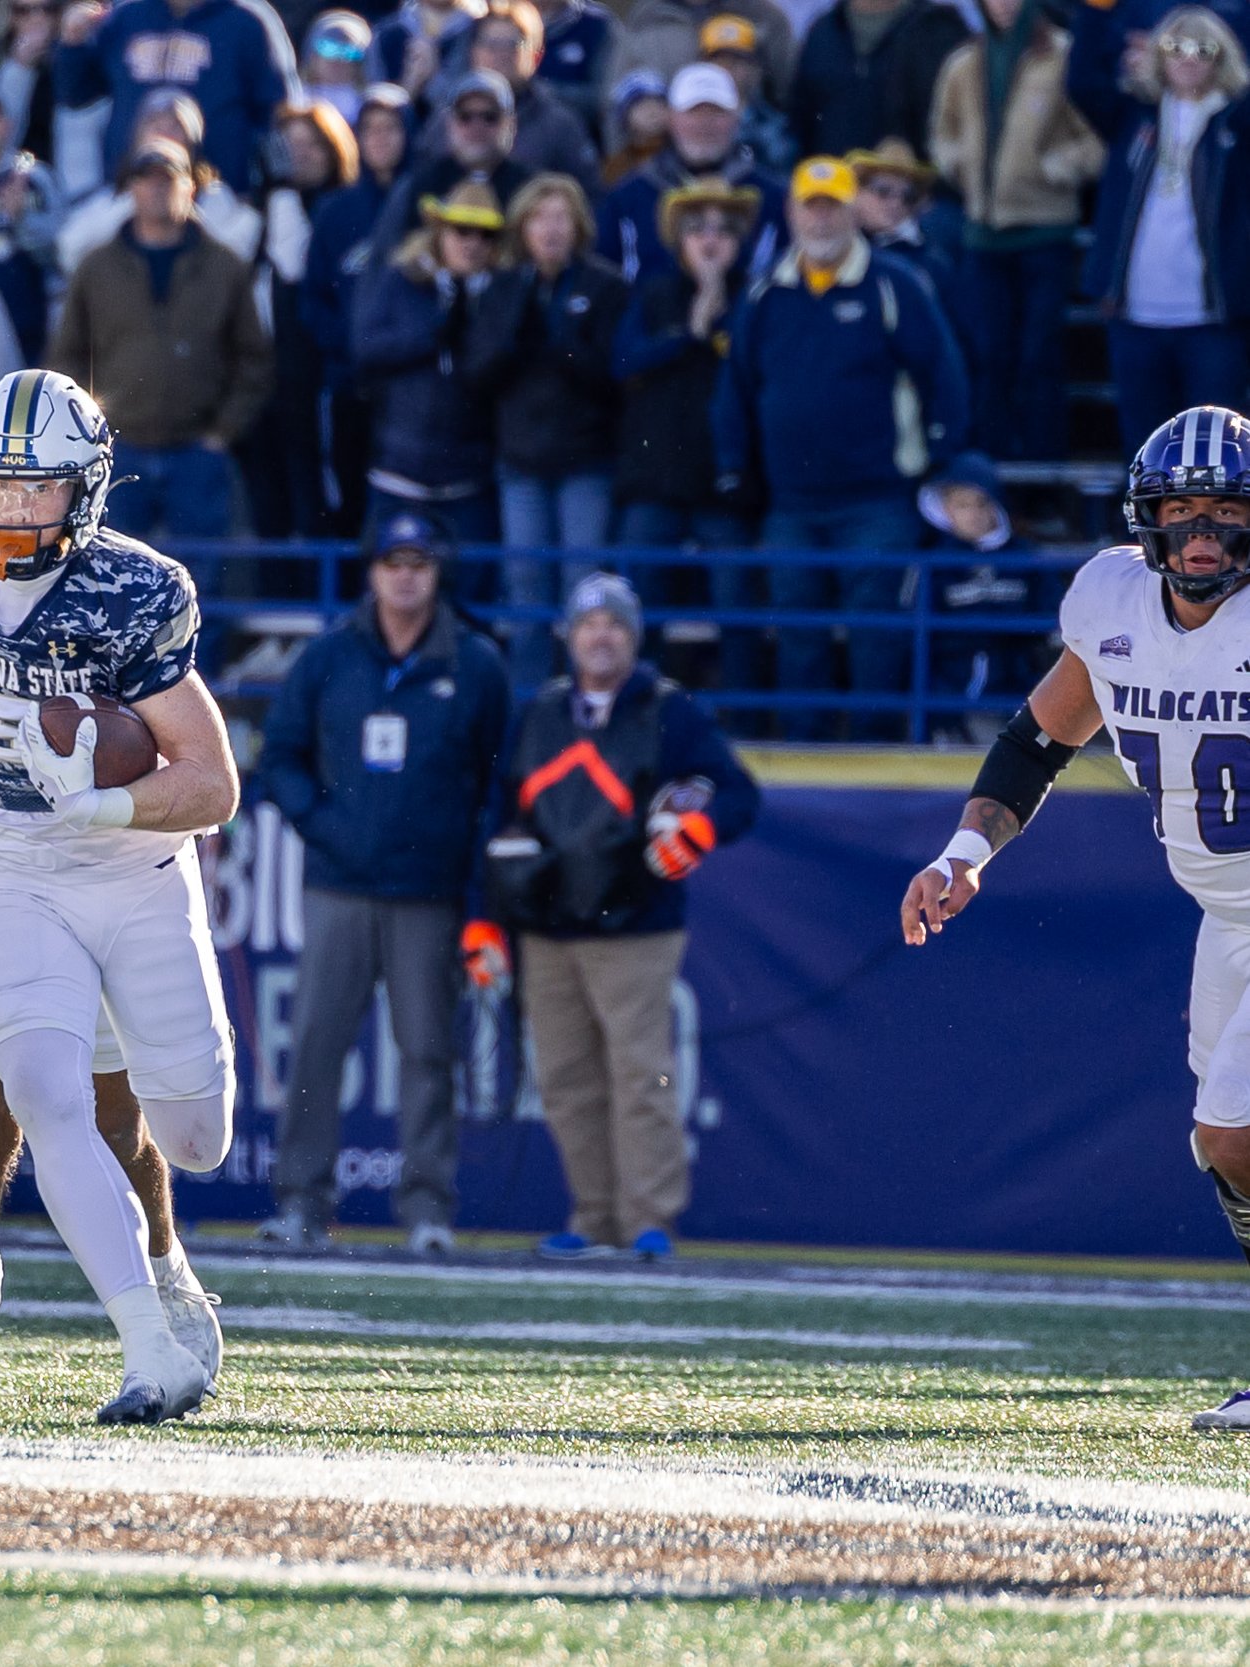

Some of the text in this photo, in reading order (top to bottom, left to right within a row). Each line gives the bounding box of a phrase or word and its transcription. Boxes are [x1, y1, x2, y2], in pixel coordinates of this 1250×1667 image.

[1, 453, 27, 466] 406
[27, 664, 95, 697] STATE
[1108, 681, 1250, 723] WILDCATS
[1116, 725, 1250, 856] 70
